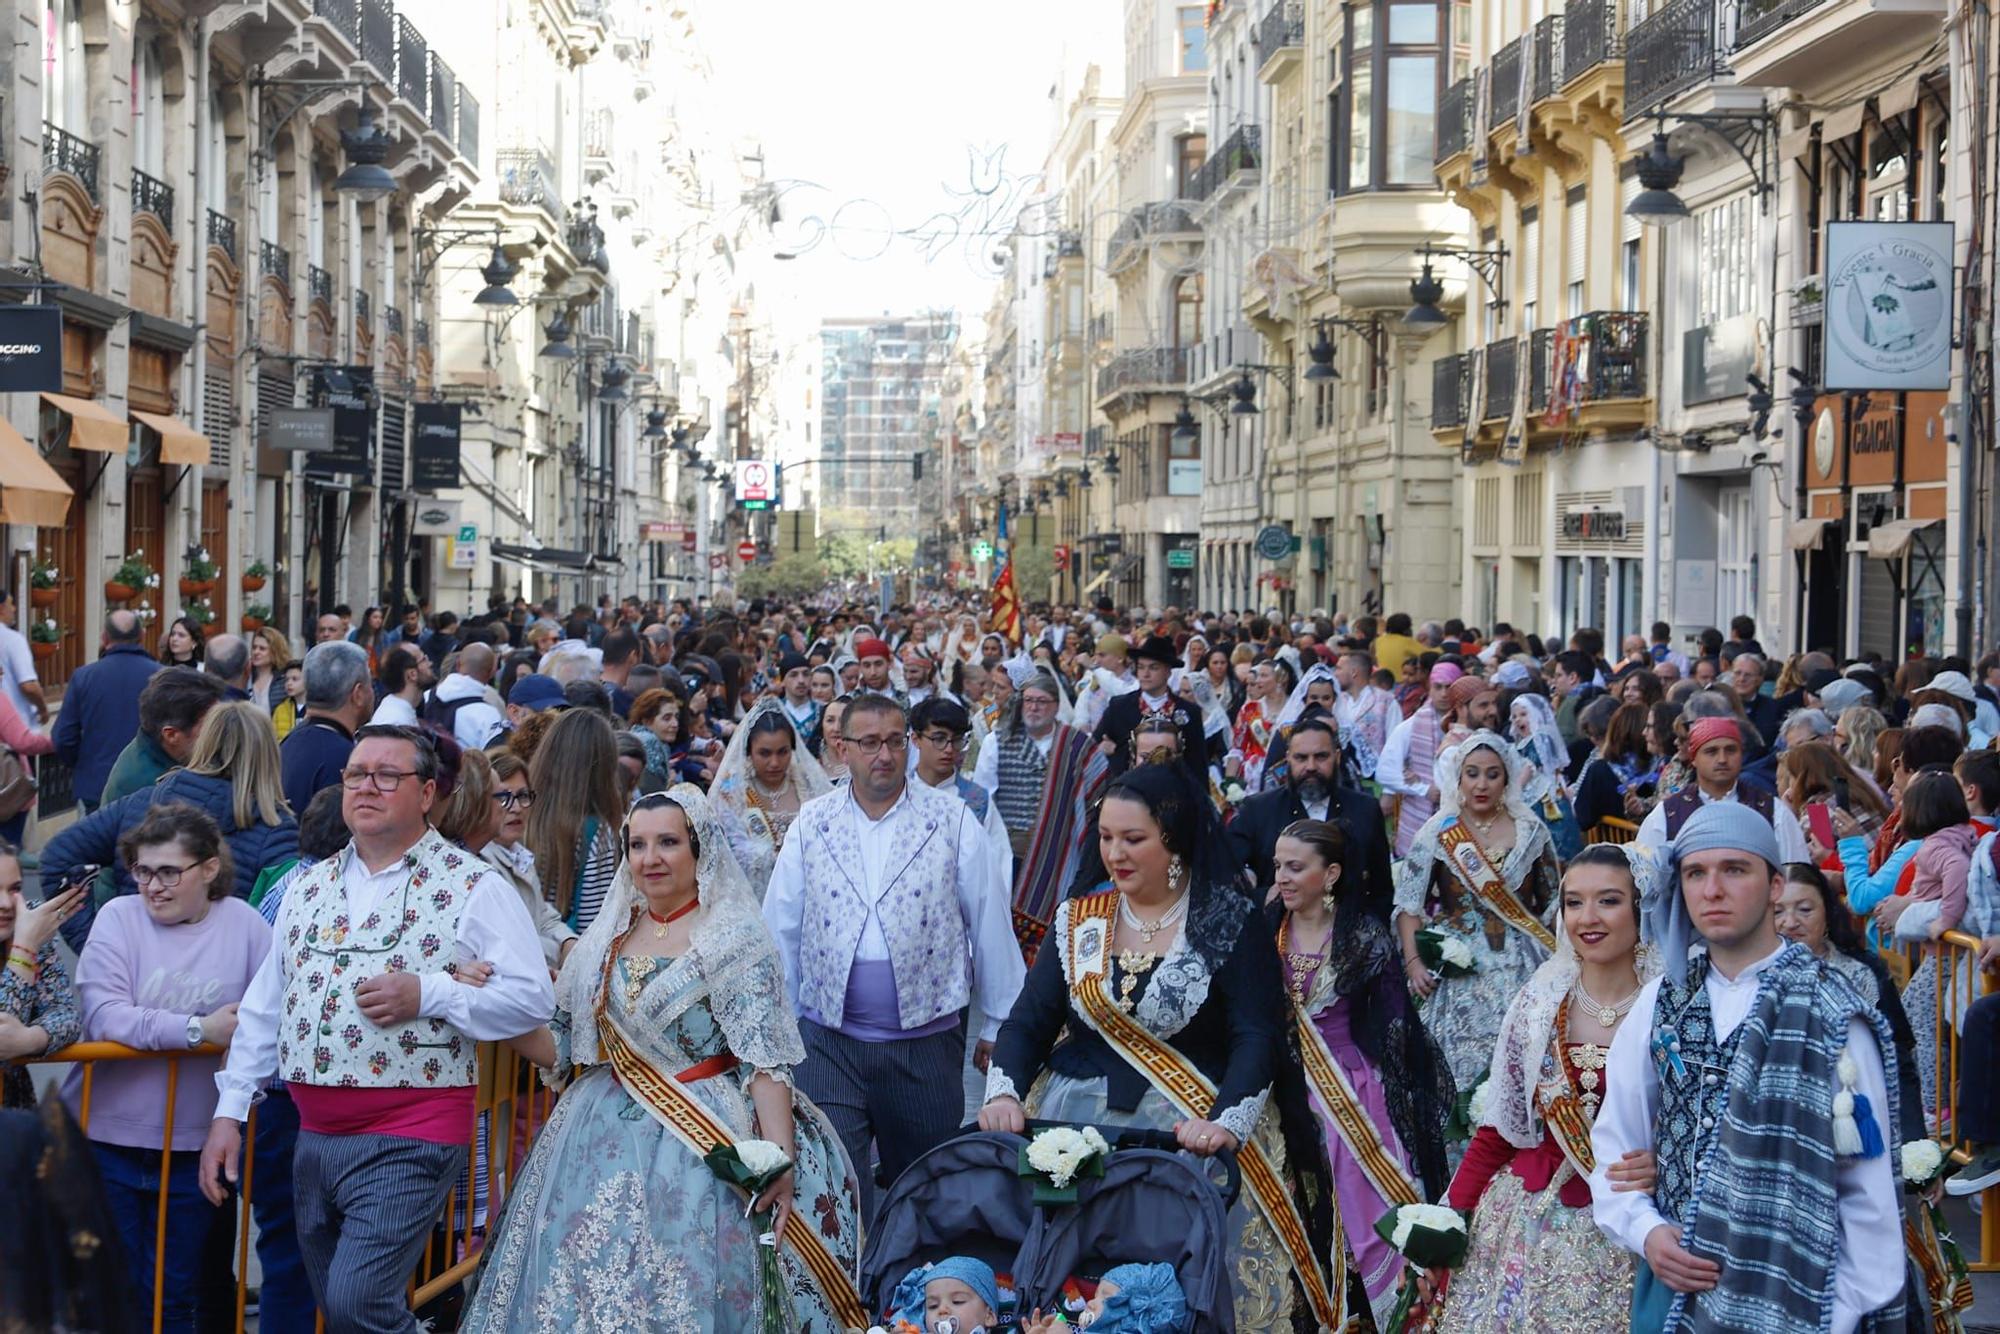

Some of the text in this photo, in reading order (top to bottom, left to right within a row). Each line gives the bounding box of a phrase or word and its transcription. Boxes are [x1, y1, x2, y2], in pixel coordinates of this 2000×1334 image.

[1833, 243, 1935, 288] Vicente Gracia
[1852, 418, 1895, 454] GRACIA
[1115, 1030, 1210, 1114] Cort d'Ho
